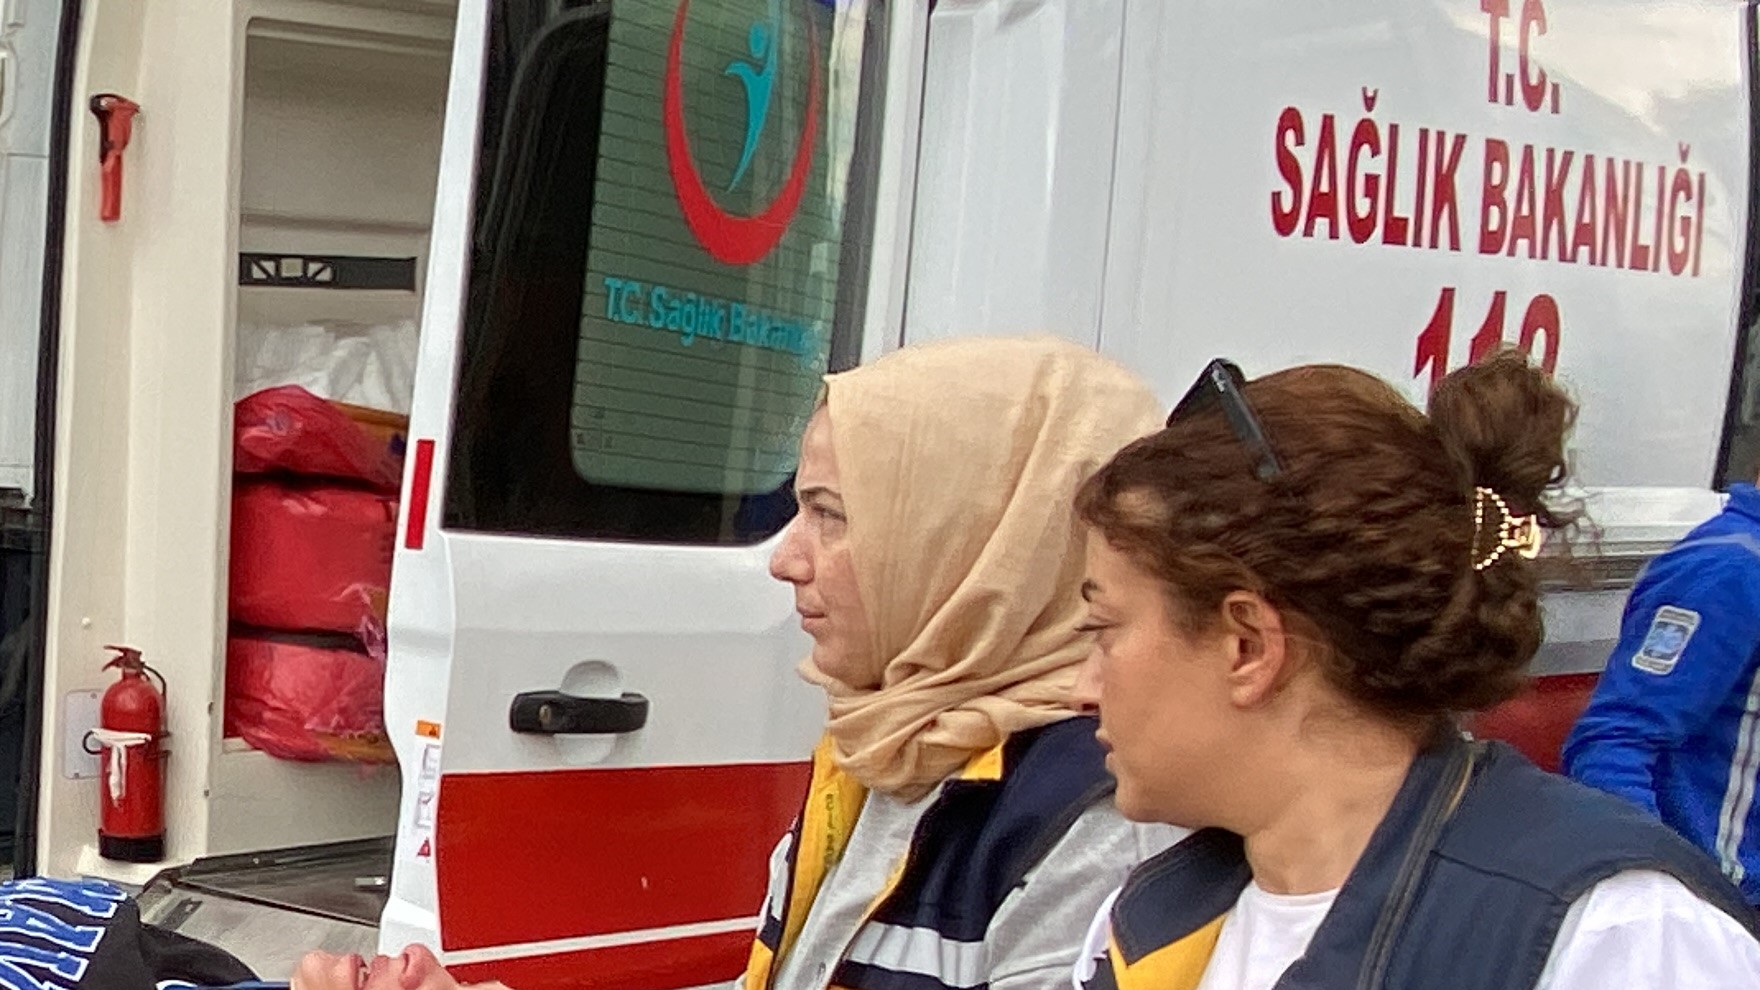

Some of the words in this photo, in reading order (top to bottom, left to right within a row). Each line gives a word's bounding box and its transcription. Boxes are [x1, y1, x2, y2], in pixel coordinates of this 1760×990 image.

[1480, 0, 1561, 114] T.C.
[1271, 86, 1467, 252] SAĞLIK
[1478, 137, 1706, 277] BAKANLIĞI
